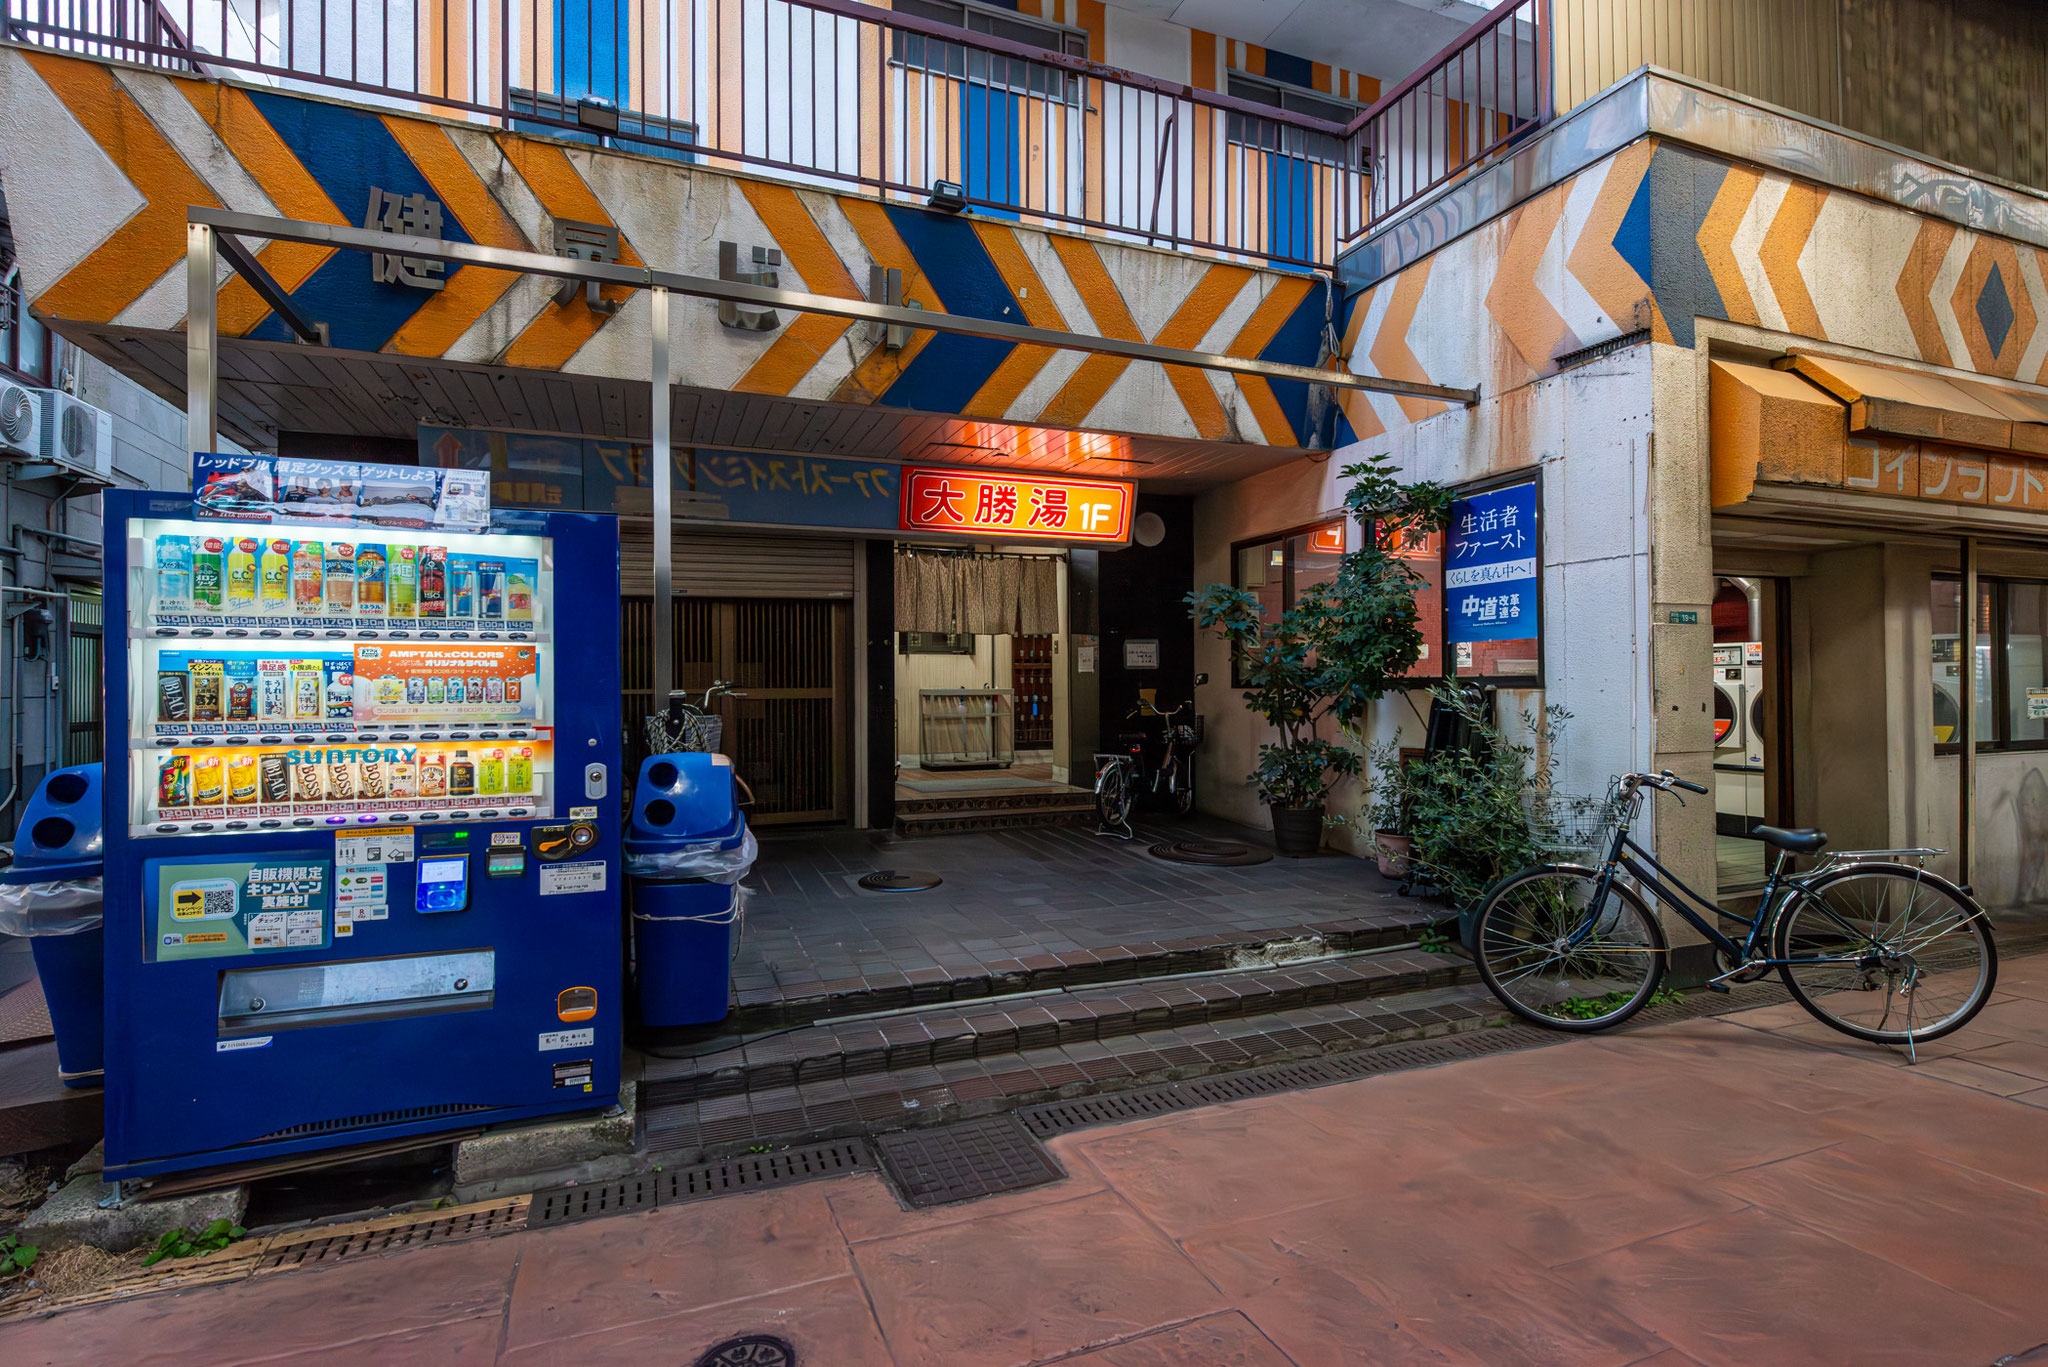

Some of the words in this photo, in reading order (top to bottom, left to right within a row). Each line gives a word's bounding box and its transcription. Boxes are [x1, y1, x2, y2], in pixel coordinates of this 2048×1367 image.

[920, 479, 1069, 528] 大勝湯
[1080, 502, 1112, 531] 1F
[1461, 504, 1519, 536] 生活者
[1455, 529, 1526, 560] ファースト
[1499, 593, 1520, 607] 改革
[1461, 594, 1498, 621] 中道
[1499, 606, 1521, 619] 連合
[226, 617, 256, 625] 160円
[259, 617, 288, 625] 160円
[293, 618, 321, 626] 170円
[325, 618, 353, 626] 170円
[358, 619, 384, 627] 130円
[448, 621, 474, 629] 200円
[164, 682, 187, 719] BLACK
[286, 748, 418, 766] SUNTORY
[265, 763, 289, 800] BLACK
[302, 764, 321, 797] BOSS
[334, 764, 353, 796] BOSS
[366, 763, 384, 796] BOSS
[160, 809, 190, 818] 120円
[194, 808, 224, 817] 120円
[228, 807, 257, 815] 120円
[260, 806, 289, 814] 120円
[248, 867, 323, 881] 自販機限定
[247, 881, 322, 896] キャンペーン
[262, 895, 309, 909] 実施中!
